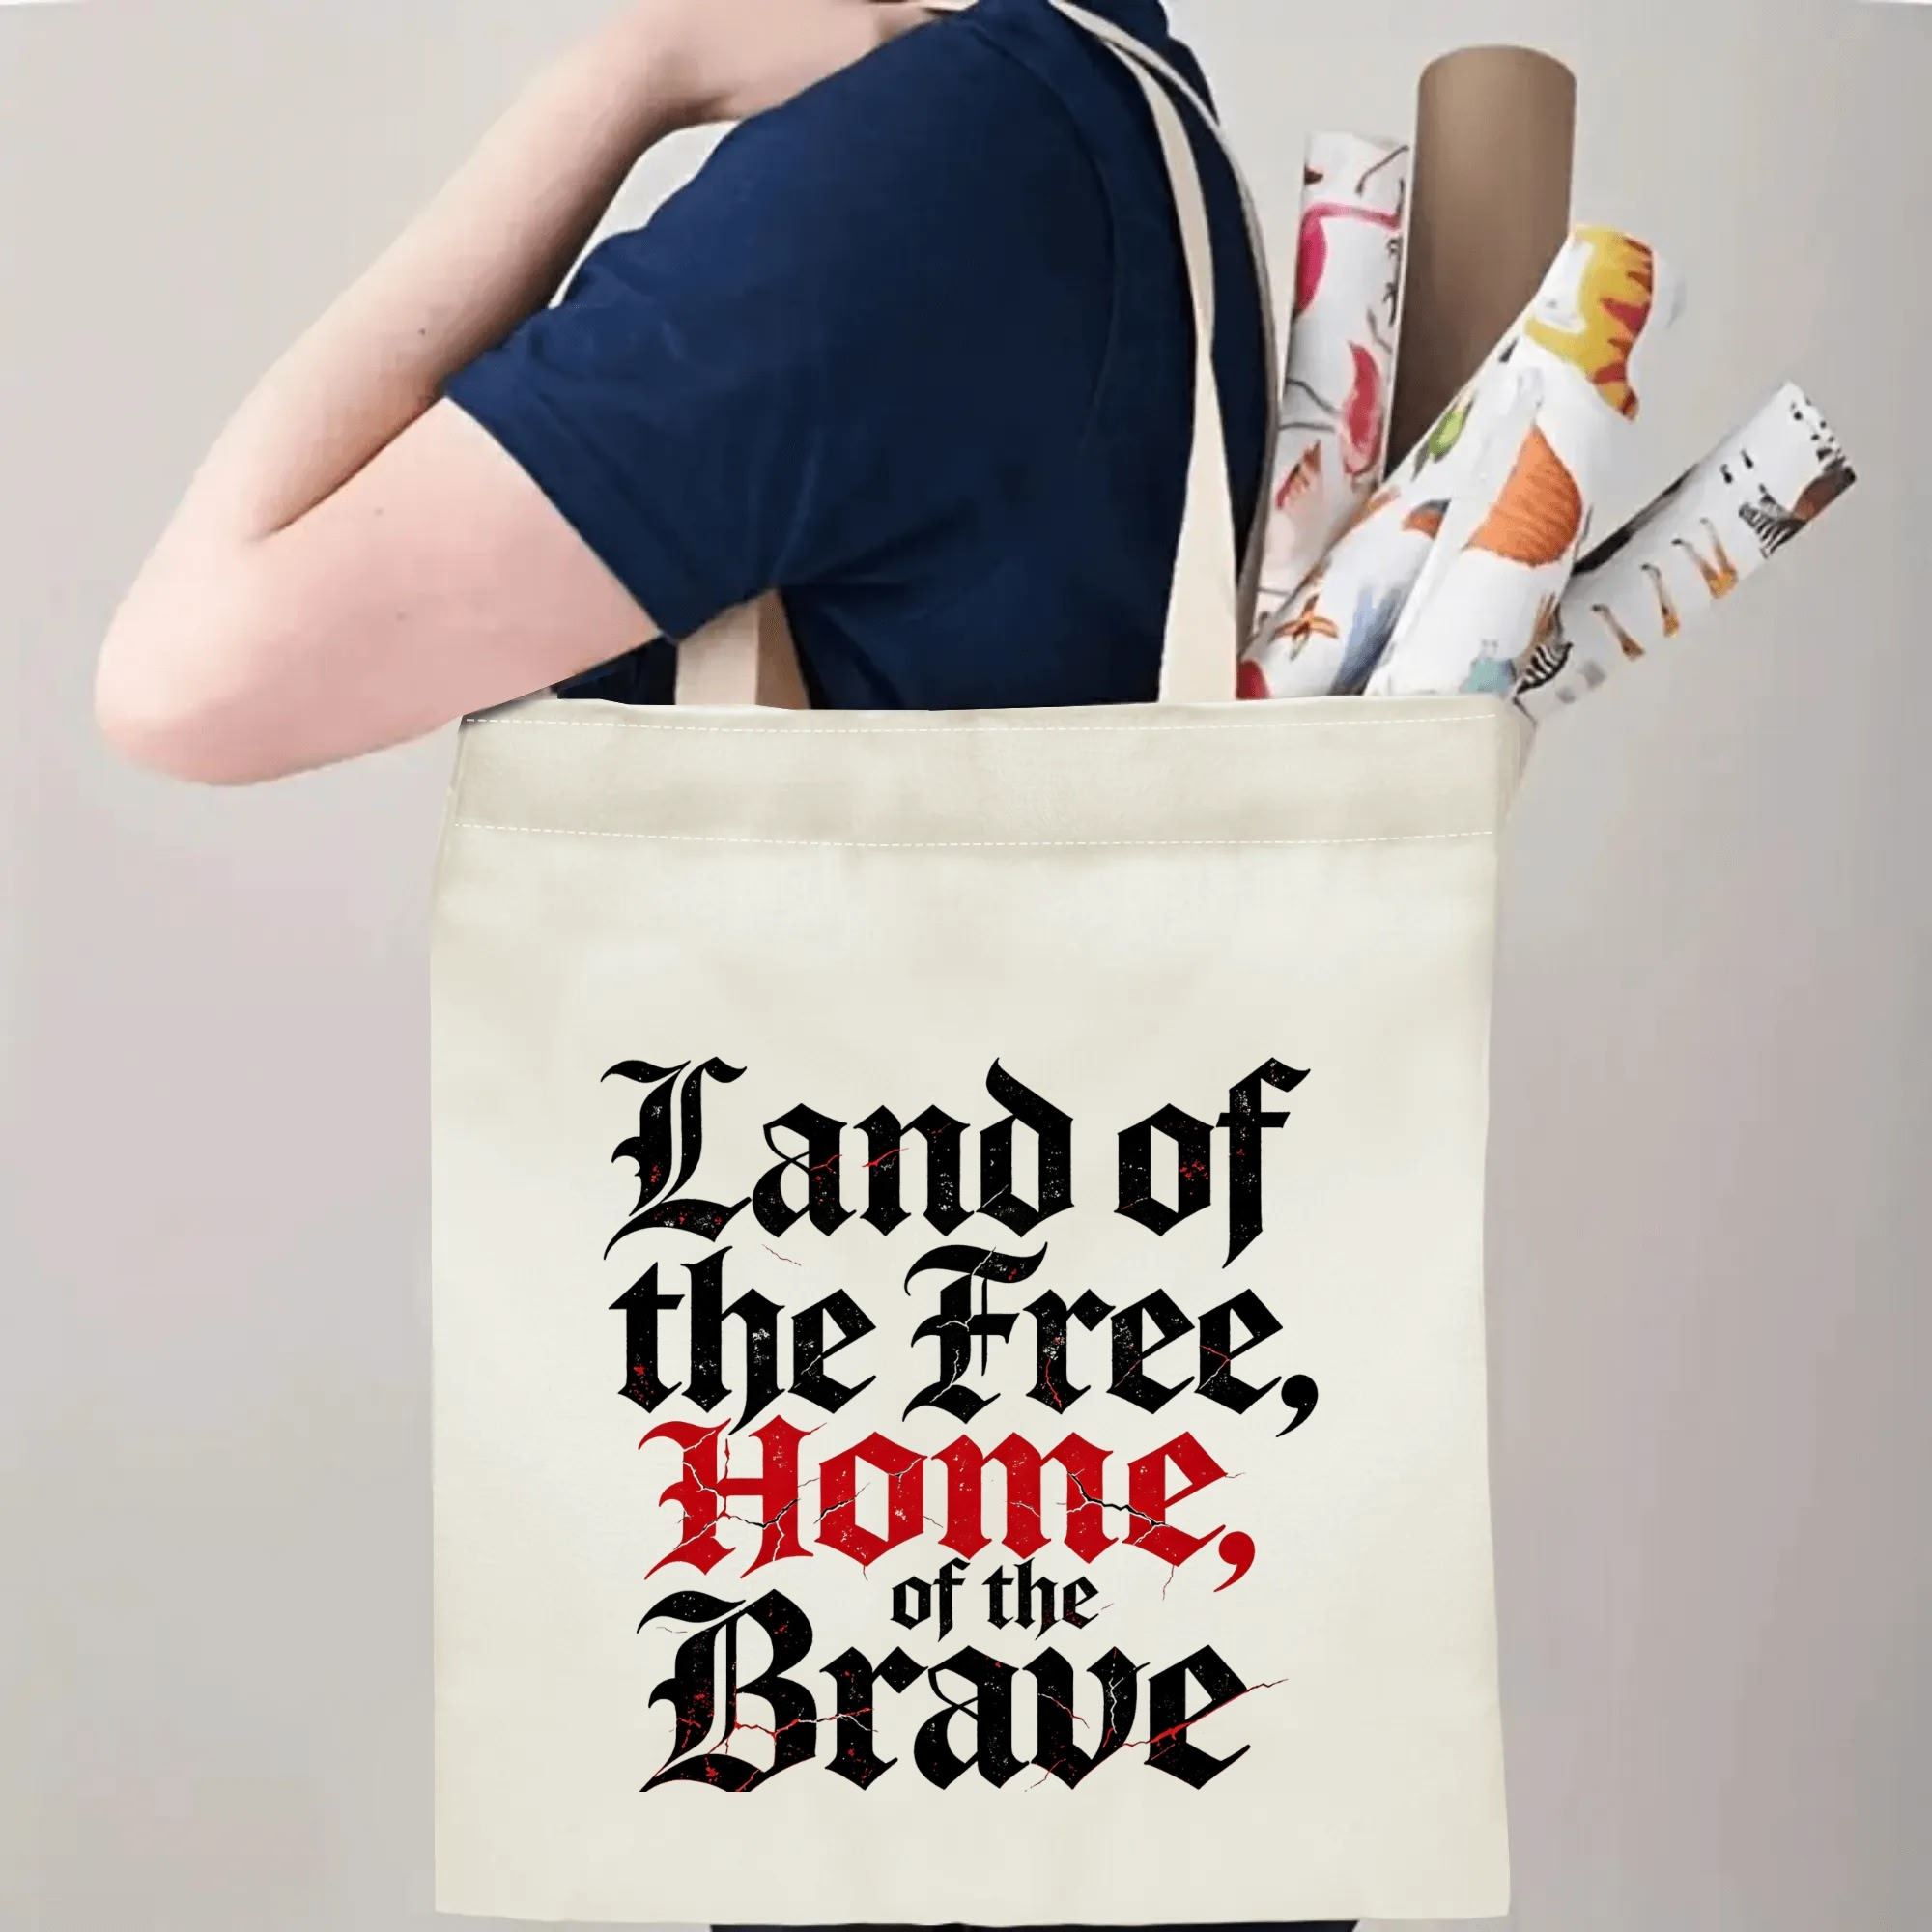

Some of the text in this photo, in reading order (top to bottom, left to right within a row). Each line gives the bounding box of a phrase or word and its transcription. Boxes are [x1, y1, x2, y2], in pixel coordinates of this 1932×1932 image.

[601, 1057, 1311, 1269] Land of
[609, 1242, 1319, 1438] the Free,
[639, 1415, 1256, 1593] Home,
[891, 1558, 1099, 1643] of the
[637, 1589, 1253, 1793] Brave
